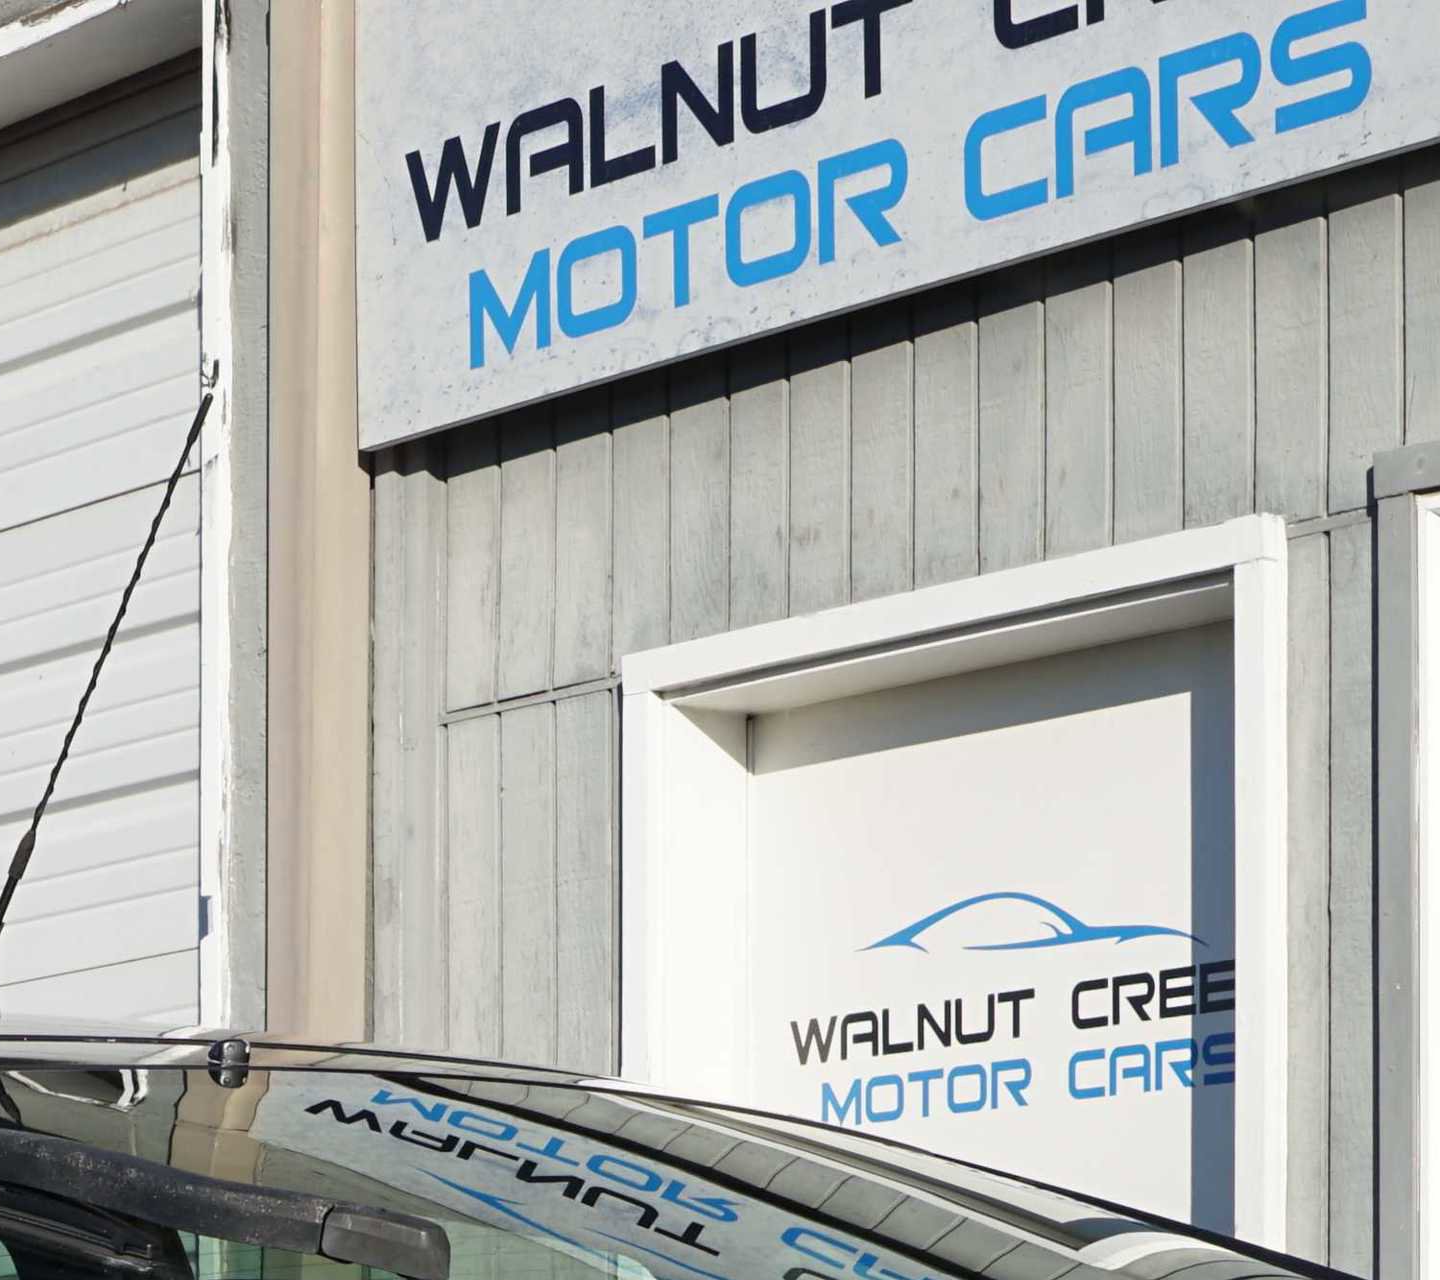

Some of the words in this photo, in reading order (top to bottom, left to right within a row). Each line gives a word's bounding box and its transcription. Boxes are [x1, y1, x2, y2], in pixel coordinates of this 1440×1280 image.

[406, 0, 912, 242] WALNUT
[469, 138, 908, 369] MOTOR
[964, 0, 1373, 221] CARS
[790, 988, 1035, 1065] WALNUT
[1071, 959, 1236, 1030] CREE
[821, 1057, 1032, 1126] MOTOR
[1068, 1032, 1236, 1099] CARS
